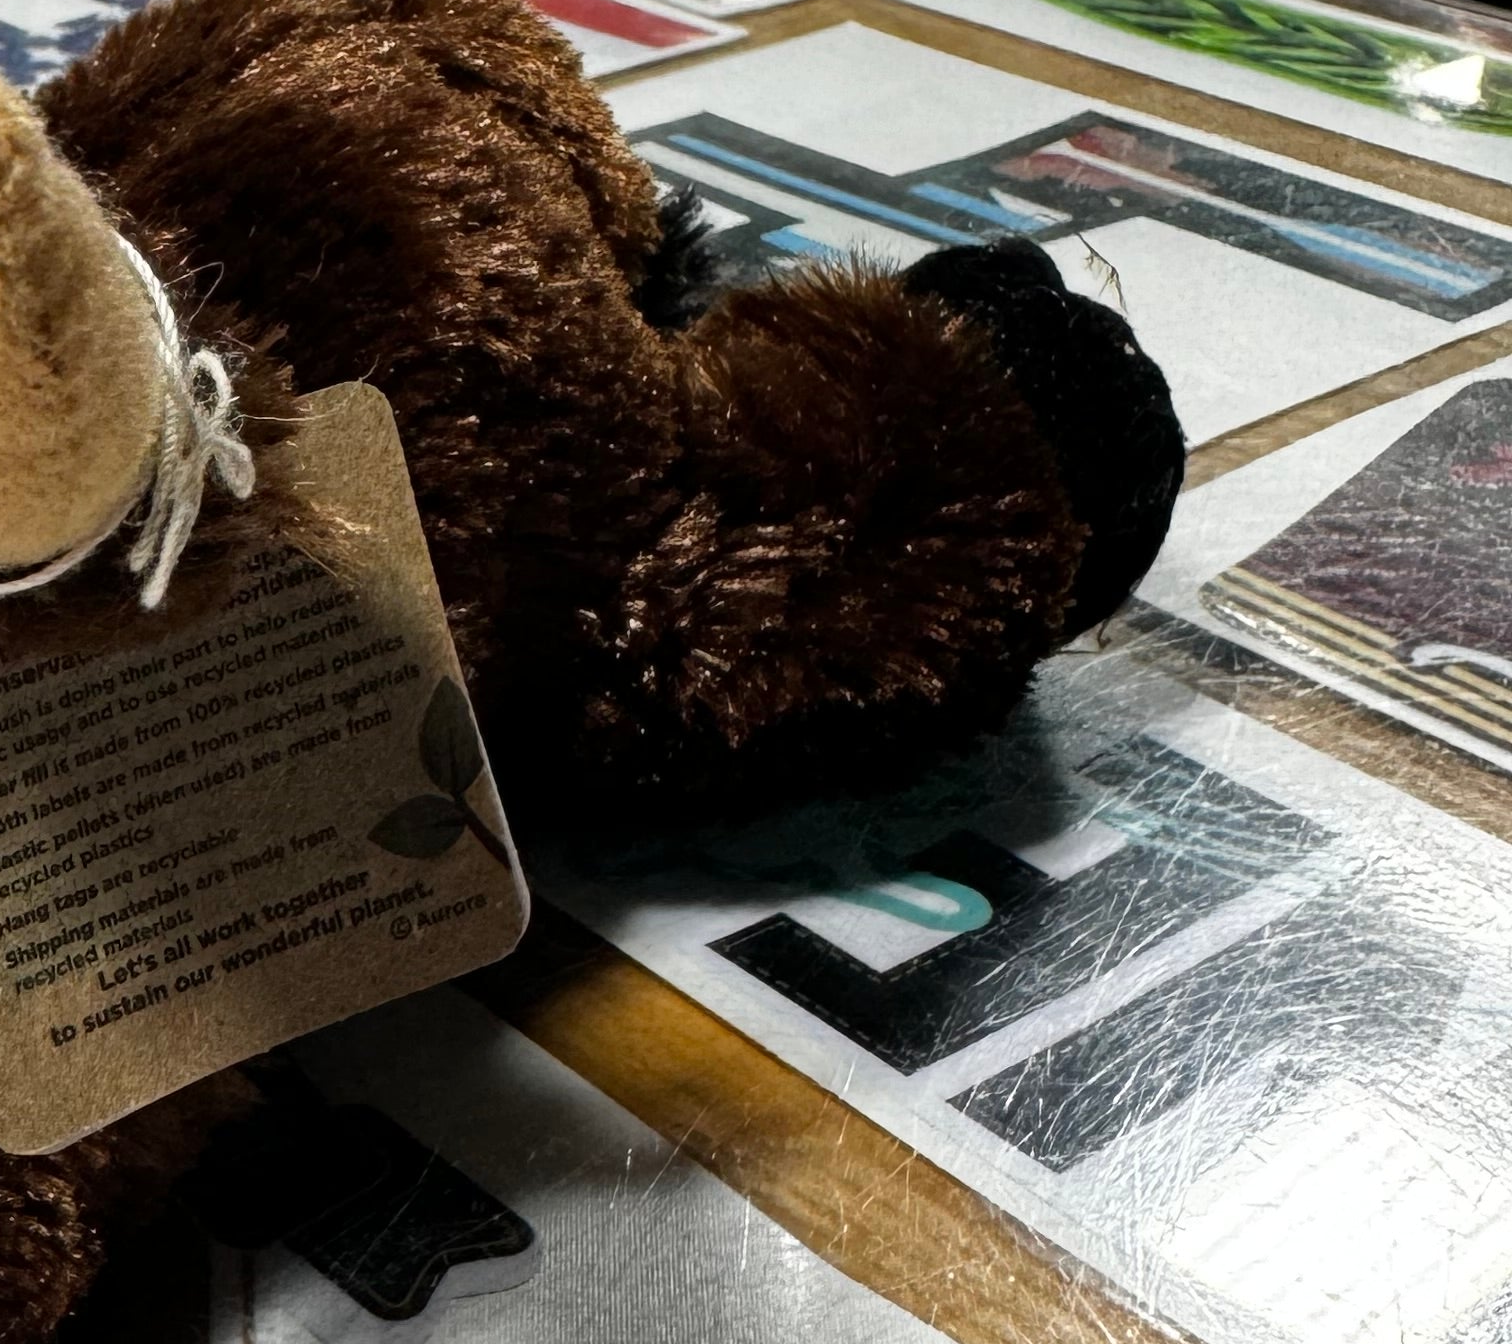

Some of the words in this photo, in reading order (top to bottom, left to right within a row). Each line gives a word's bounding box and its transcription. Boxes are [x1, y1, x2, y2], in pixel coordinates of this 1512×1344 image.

[14, 722, 70, 757] usage
[78, 703, 112, 730] and
[120, 693, 138, 713] to
[146, 680, 177, 703] use
[184, 643, 267, 692] recycled
[21, 762, 47, 788] fill
[74, 732, 128, 767] made
[135, 712, 180, 744] from
[187, 691, 237, 725] 100%
[243, 657, 327, 705] recycled
[331, 630, 404, 672] plastics
[58, 673, 114, 711] doing
[120, 654, 167, 685] their
[172, 639, 211, 669] part
[218, 629, 236, 648] to
[243, 610, 285, 641] help
[31, 782, 90, 820] labels
[96, 771, 126, 794] are
[131, 745, 187, 781] made
[192, 726, 236, 758] from
[242, 693, 326, 741] recycled
[331, 659, 419, 706] materials
[52, 806, 120, 850] pellets
[191, 759, 245, 796] used)
[251, 748, 281, 771] are
[286, 722, 340, 758] made
[345, 703, 390, 735] from
[5, 919, 94, 971] Shipping
[98, 878, 188, 929] materials
[196, 868, 226, 890] are
[230, 841, 285, 877] made
[290, 821, 336, 854] from
[55, 883, 98, 914] tags
[103, 870, 132, 892] are
[138, 823, 238, 879] recyclable
[80, 822, 155, 868] plastics
[13, 944, 98, 996] recycled
[102, 905, 192, 955] materials
[50, 1019, 75, 1046] to
[81, 979, 168, 1032] sustain
[174, 963, 215, 993] our
[220, 908, 344, 975] wonderful
[349, 874, 434, 926] planet.
[98, 950, 158, 990] Let's
[162, 935, 191, 963] all
[197, 909, 256, 949] work
[262, 865, 370, 926] together
[416, 888, 486, 931] Aurora
